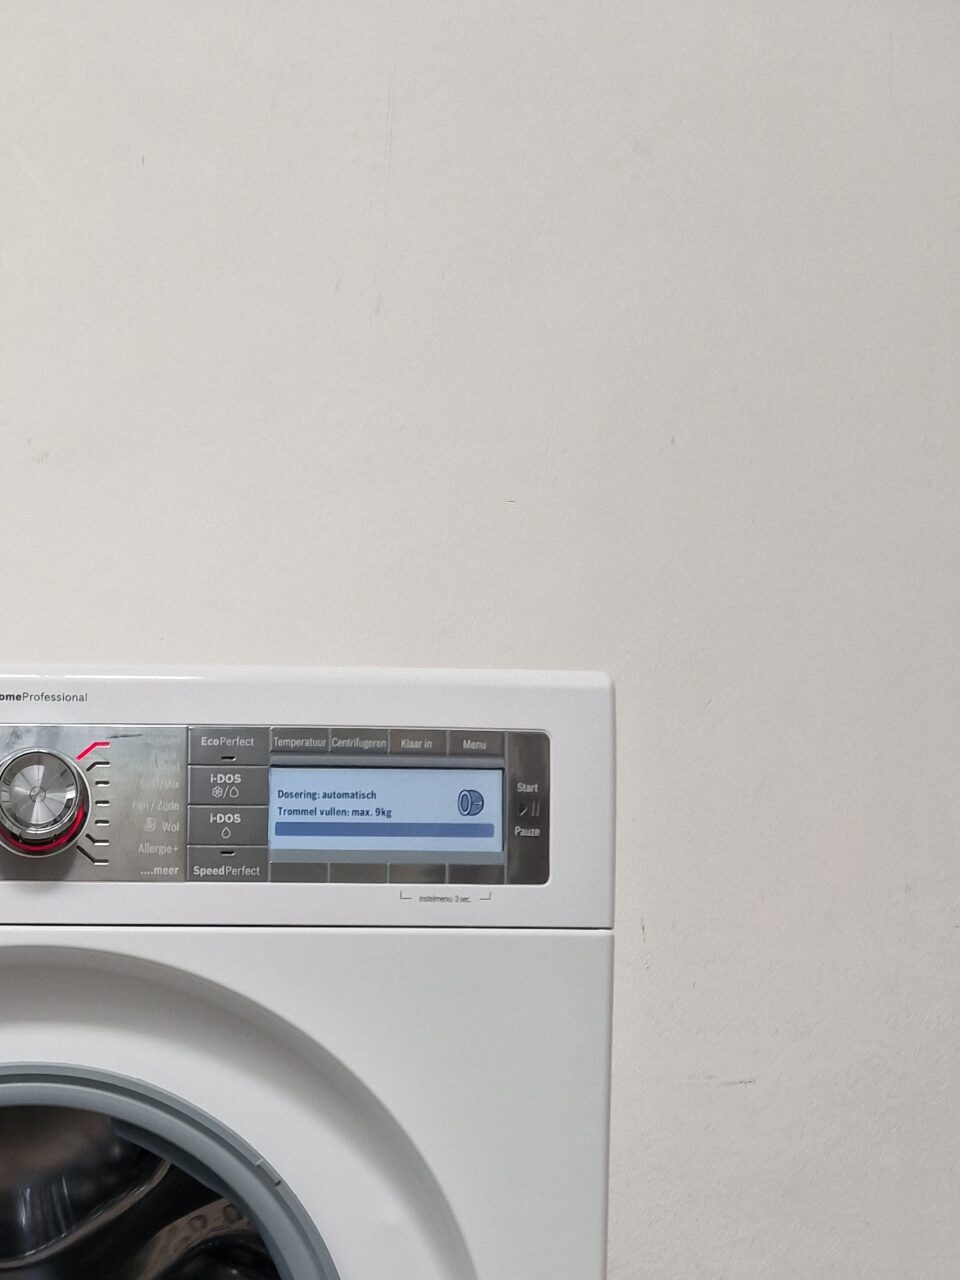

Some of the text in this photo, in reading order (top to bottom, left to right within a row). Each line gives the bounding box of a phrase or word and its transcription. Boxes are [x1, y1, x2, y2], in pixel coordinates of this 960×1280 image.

[201, 737, 254, 747] EcoPerfect
[273, 737, 327, 748] Temperatuur
[331, 737, 387, 749] Centrifugeren
[401, 739, 433, 749] Klaar in
[463, 740, 487, 750] Menu
[210, 774, 242, 783] i-DOS
[517, 783, 539, 792] Start
[277, 790, 377, 801] Dosering: automatisch
[278, 807, 392, 818] Trommel vullen: max. 9kg
[210, 813, 242, 823] i-DOS
[162, 821, 180, 832] Wol
[193, 866, 260, 877] SpeedPerfect
